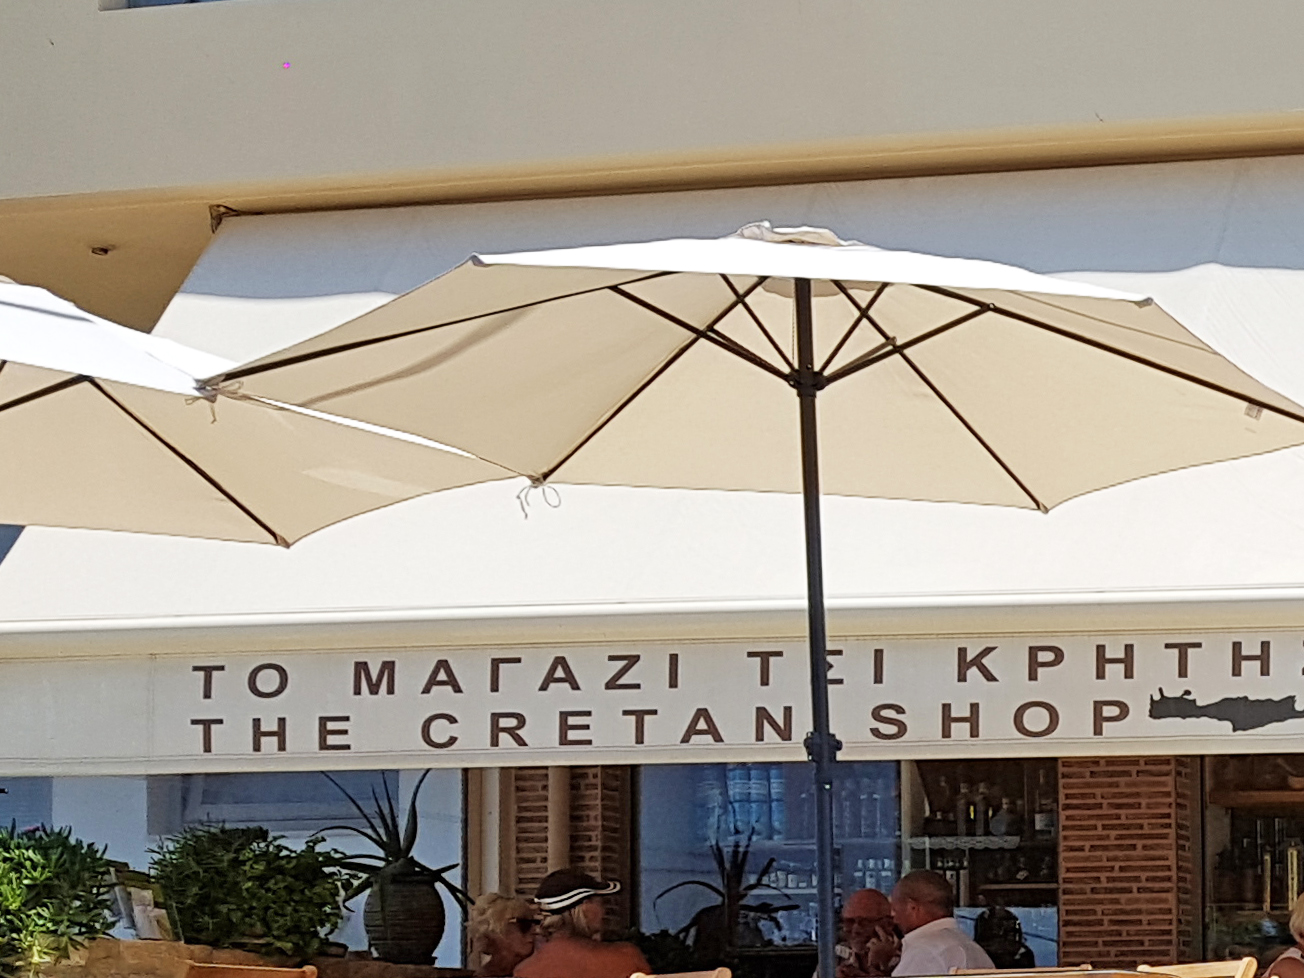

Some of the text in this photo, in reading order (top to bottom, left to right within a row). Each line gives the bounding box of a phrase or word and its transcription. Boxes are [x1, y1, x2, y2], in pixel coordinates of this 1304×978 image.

[192, 663, 288, 700] ΤΟ
[353, 653, 680, 696] ΜΑΓΑΖΙ
[191, 699, 1131, 754] THE CRETAN SHOP
